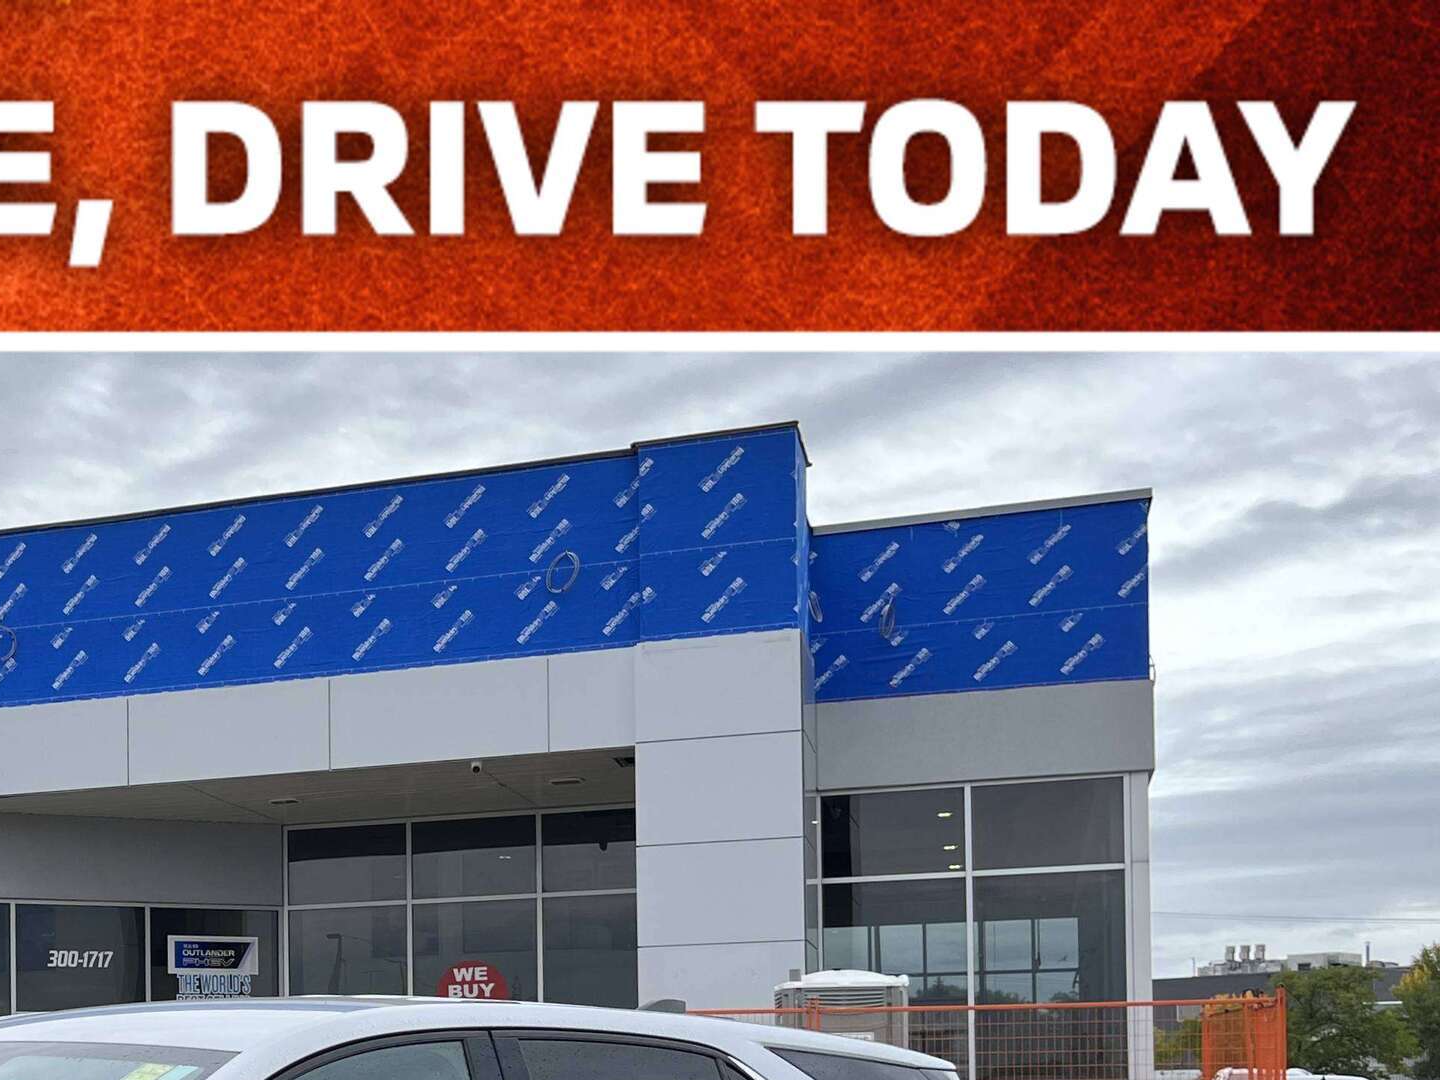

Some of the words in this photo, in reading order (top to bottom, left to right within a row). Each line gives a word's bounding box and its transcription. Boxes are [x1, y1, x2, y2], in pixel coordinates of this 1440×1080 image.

[47, 950, 114, 968] 300-1717
[182, 949, 236, 957] OUTLANDER
[453, 966, 488, 982] WE
[178, 974, 200, 994] THE
[201, 974, 252, 994] WORLD'S
[447, 983, 495, 998] BUY
